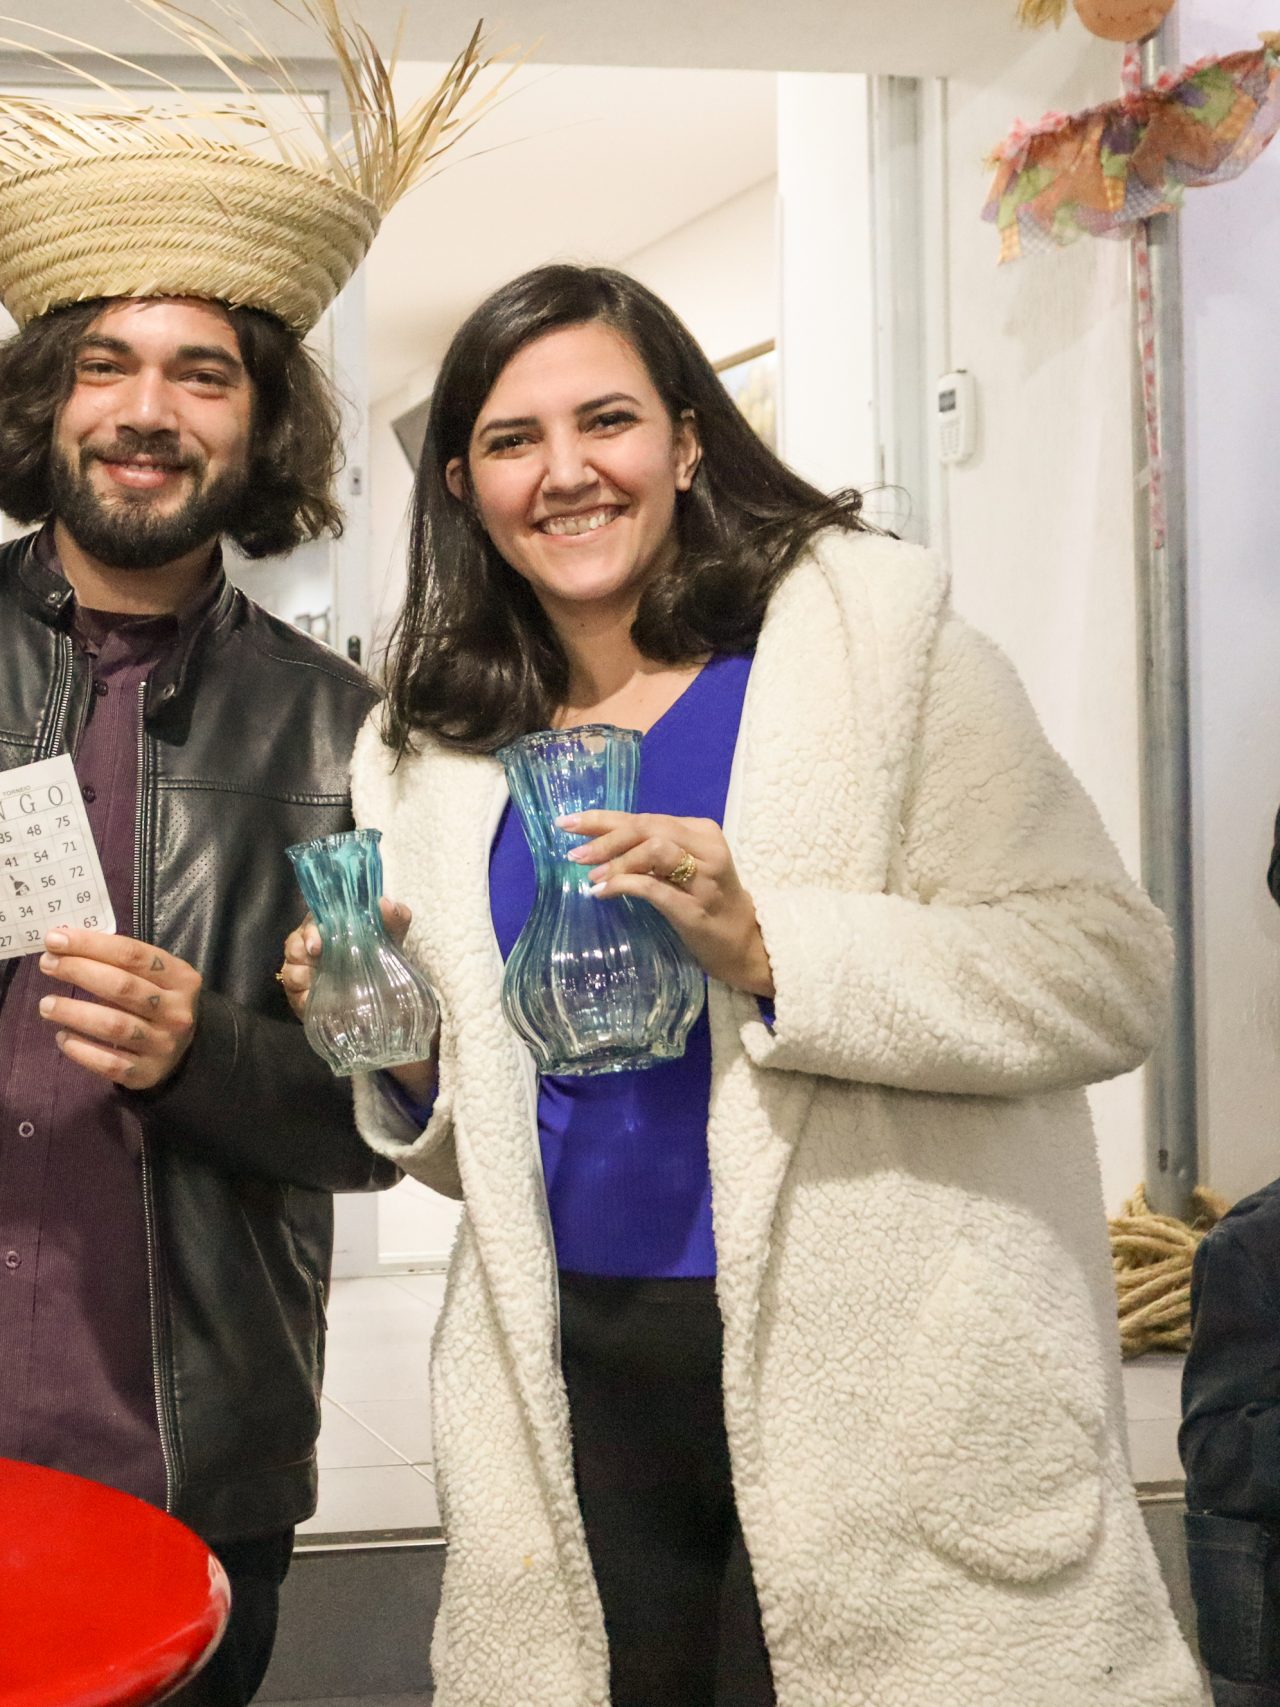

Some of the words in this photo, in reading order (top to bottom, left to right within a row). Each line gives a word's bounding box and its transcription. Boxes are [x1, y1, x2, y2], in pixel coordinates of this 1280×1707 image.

[26, 824, 42, 837] 48
[55, 815, 71, 829] 75
[4, 856, 20, 868] 41
[33, 850, 49, 863] 54
[62, 841, 78, 854] 71
[41, 875, 56, 888] 56
[69, 866, 85, 878] 72
[19, 905, 34, 918] 34
[48, 900, 62, 913] 57
[77, 891, 91, 904] 69
[26, 930, 41, 942] 32
[84, 916, 98, 929] 63
